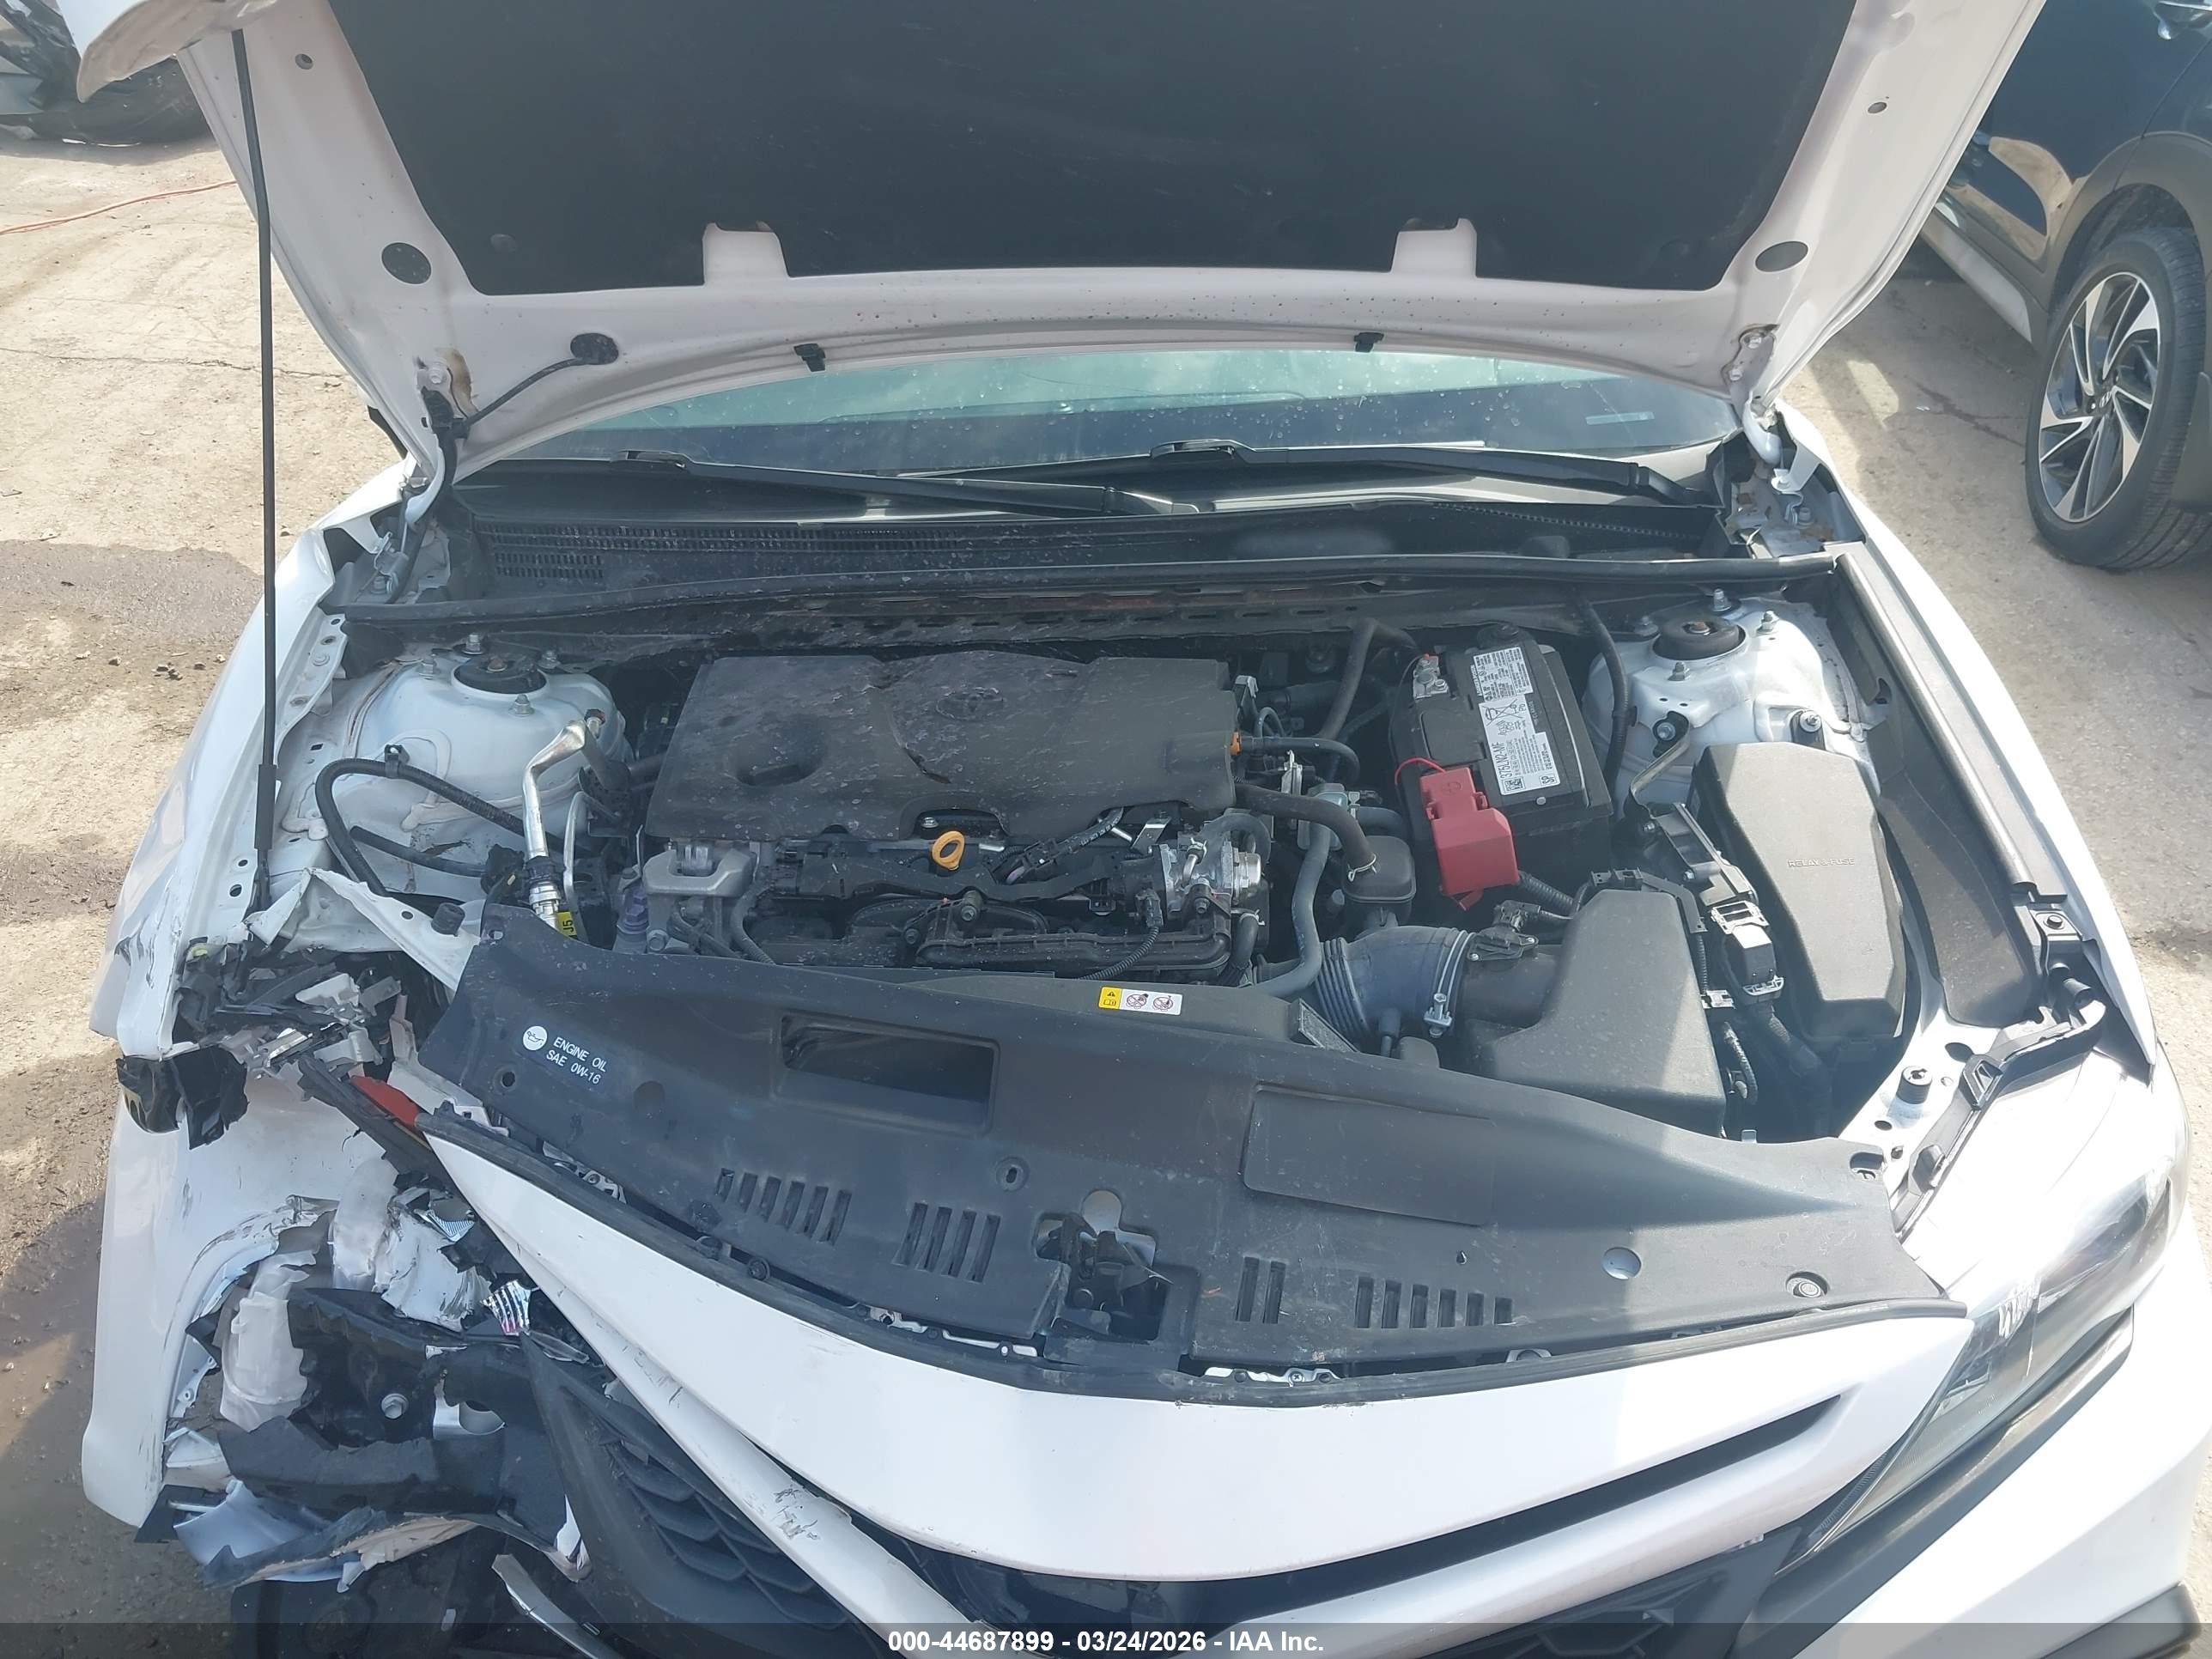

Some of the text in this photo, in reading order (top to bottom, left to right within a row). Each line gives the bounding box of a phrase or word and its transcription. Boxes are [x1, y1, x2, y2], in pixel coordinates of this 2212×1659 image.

[1540, 775, 1555, 785] SP
[1787, 859, 1820, 867] RELAY
[1830, 858, 1855, 866] FUSE
[562, 920, 574, 933] J5
[553, 1036, 607, 1073] ENGINE OIL
[546, 1049, 601, 1085] SAE 0W-16
